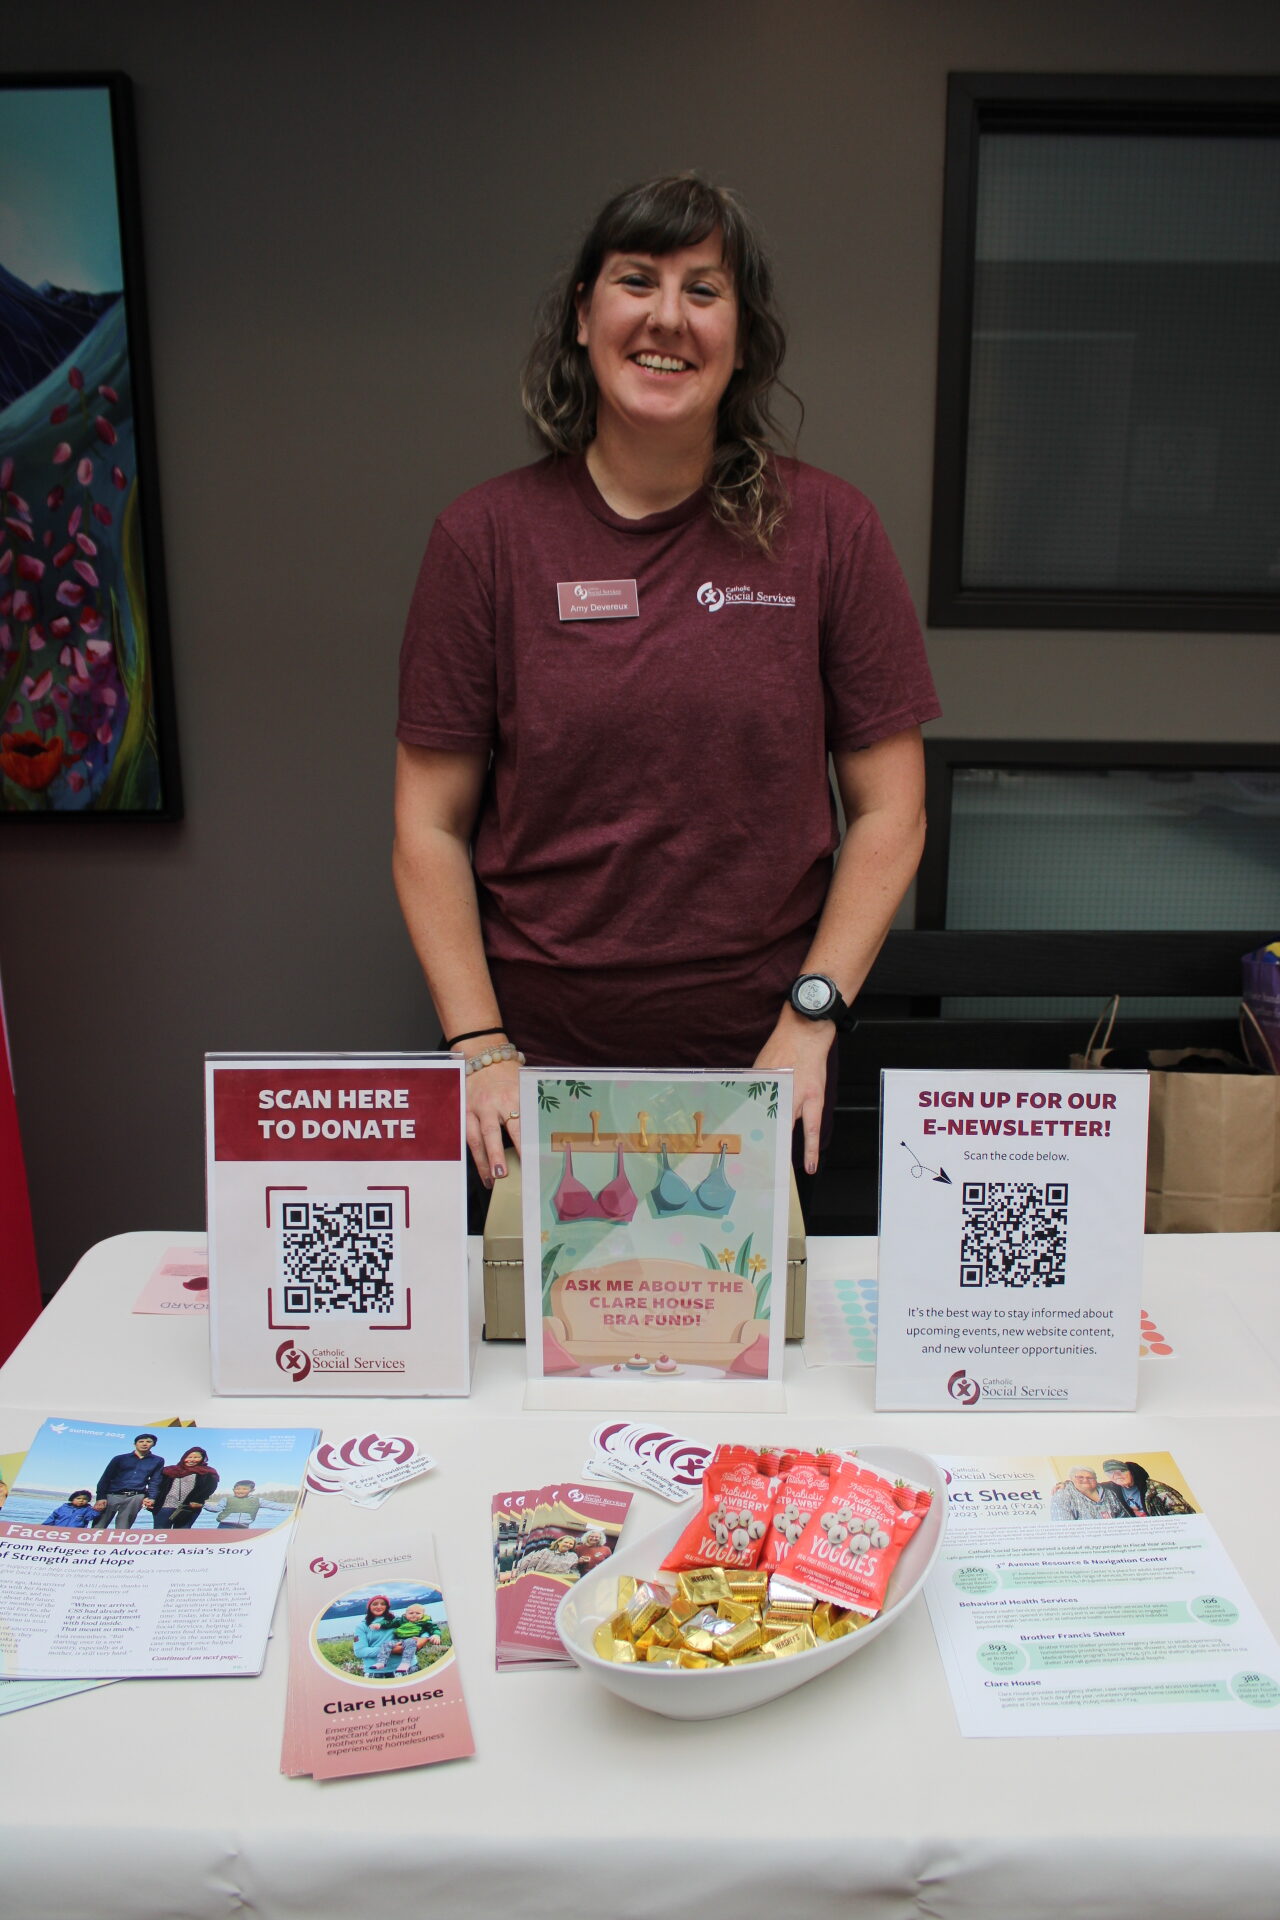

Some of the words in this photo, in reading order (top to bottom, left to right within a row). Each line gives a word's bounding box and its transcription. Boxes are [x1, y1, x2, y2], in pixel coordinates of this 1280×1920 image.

[725, 592, 754, 602] Social
[757, 592, 796, 603] Services
[570, 604, 588, 613] Amy
[590, 602, 628, 612] Devereux
[258, 1089, 331, 1110] SCAN
[338, 1089, 409, 1109] HERE
[918, 1090, 974, 1108] SIGN
[980, 1092, 1010, 1108] UP
[1016, 1092, 1062, 1109] FOR
[1068, 1092, 1117, 1109] OUR
[258, 1120, 295, 1139] TO
[302, 1120, 416, 1139] DONATE
[923, 1118, 1111, 1137] E-NEWSLETTER!
[964, 1150, 988, 1160] Scan
[990, 1151, 1007, 1160] the
[1009, 1151, 1034, 1161] code
[1036, 1151, 1070, 1161] below.
[565, 1280, 601, 1291] ASK
[606, 1280, 634, 1292] ME
[639, 1280, 702, 1293] ABOUT
[707, 1281, 743, 1293] THE
[589, 1296, 647, 1309] CLARE
[652, 1297, 715, 1310] HOUSE
[603, 1314, 639, 1326] BRA
[644, 1314, 701, 1326] FUND!
[908, 1307, 924, 1317] It's
[925, 1308, 944, 1318] the
[946, 1308, 970, 1318] best
[972, 1310, 992, 1320] way
[994, 1309, 1006, 1318] to
[1008, 1309, 1029, 1321] stay
[1031, 1308, 1081, 1319] informed
[1082, 1308, 1113, 1319] about
[906, 1326, 960, 1339] upcoming
[962, 1328, 1000, 1338] events,
[1002, 1328, 1024, 1336] new
[1026, 1326, 1068, 1337] website
[1069, 1327, 1114, 1338] content,
[312, 1349, 345, 1357] Catholic
[921, 1343, 942, 1354] and
[944, 1346, 966, 1354] new
[968, 1344, 1019, 1354] volunteer
[1021, 1344, 1097, 1357] opportunities.
[313, 1357, 350, 1369] Social
[354, 1357, 405, 1370] Services
[982, 1385, 1017, 1397] Social
[1021, 1386, 1068, 1397] Services
[69, 1428, 105, 1436] summer
[646, 1468, 674, 1487] Providing
[952, 1472, 985, 1480] Social
[785, 1486, 825, 1501] Probiotic
[979, 1489, 1042, 1502] Sheet
[7, 1525, 71, 1542] Faces
[77, 1530, 102, 1542] of
[107, 1530, 168, 1546] Hope
[0, 1541, 33, 1551] From
[38, 1545, 90, 1556] Refugee
[110, 1547, 173, 1556] Advocate:
[178, 1547, 214, 1555] Asia's
[220, 1547, 253, 1556] Story
[810, 1535, 878, 1576] YOGGIES
[11, 1553, 68, 1565] Strength
[72, 1557, 97, 1565] and
[102, 1558, 135, 1566] Hope
[339, 1560, 368, 1569] Social
[372, 1554, 412, 1565] Services
[1091, 1557, 1138, 1565] Navigation
[960, 1567, 984, 1575] 3,869
[960, 1600, 1007, 1608] Behavioral
[323, 1700, 375, 1714] Clare
[381, 1689, 444, 1707] House
[325, 1724, 374, 1735] Emergency
[375, 1718, 404, 1729] shelter
[325, 1730, 369, 1741] expectant
[370, 1727, 398, 1736] moms
[326, 1739, 364, 1749] mothers
[365, 1735, 385, 1743] with
[387, 1730, 422, 1741] children
[327, 1743, 383, 1756] experiencing
[385, 1733, 445, 1748] homelessness
